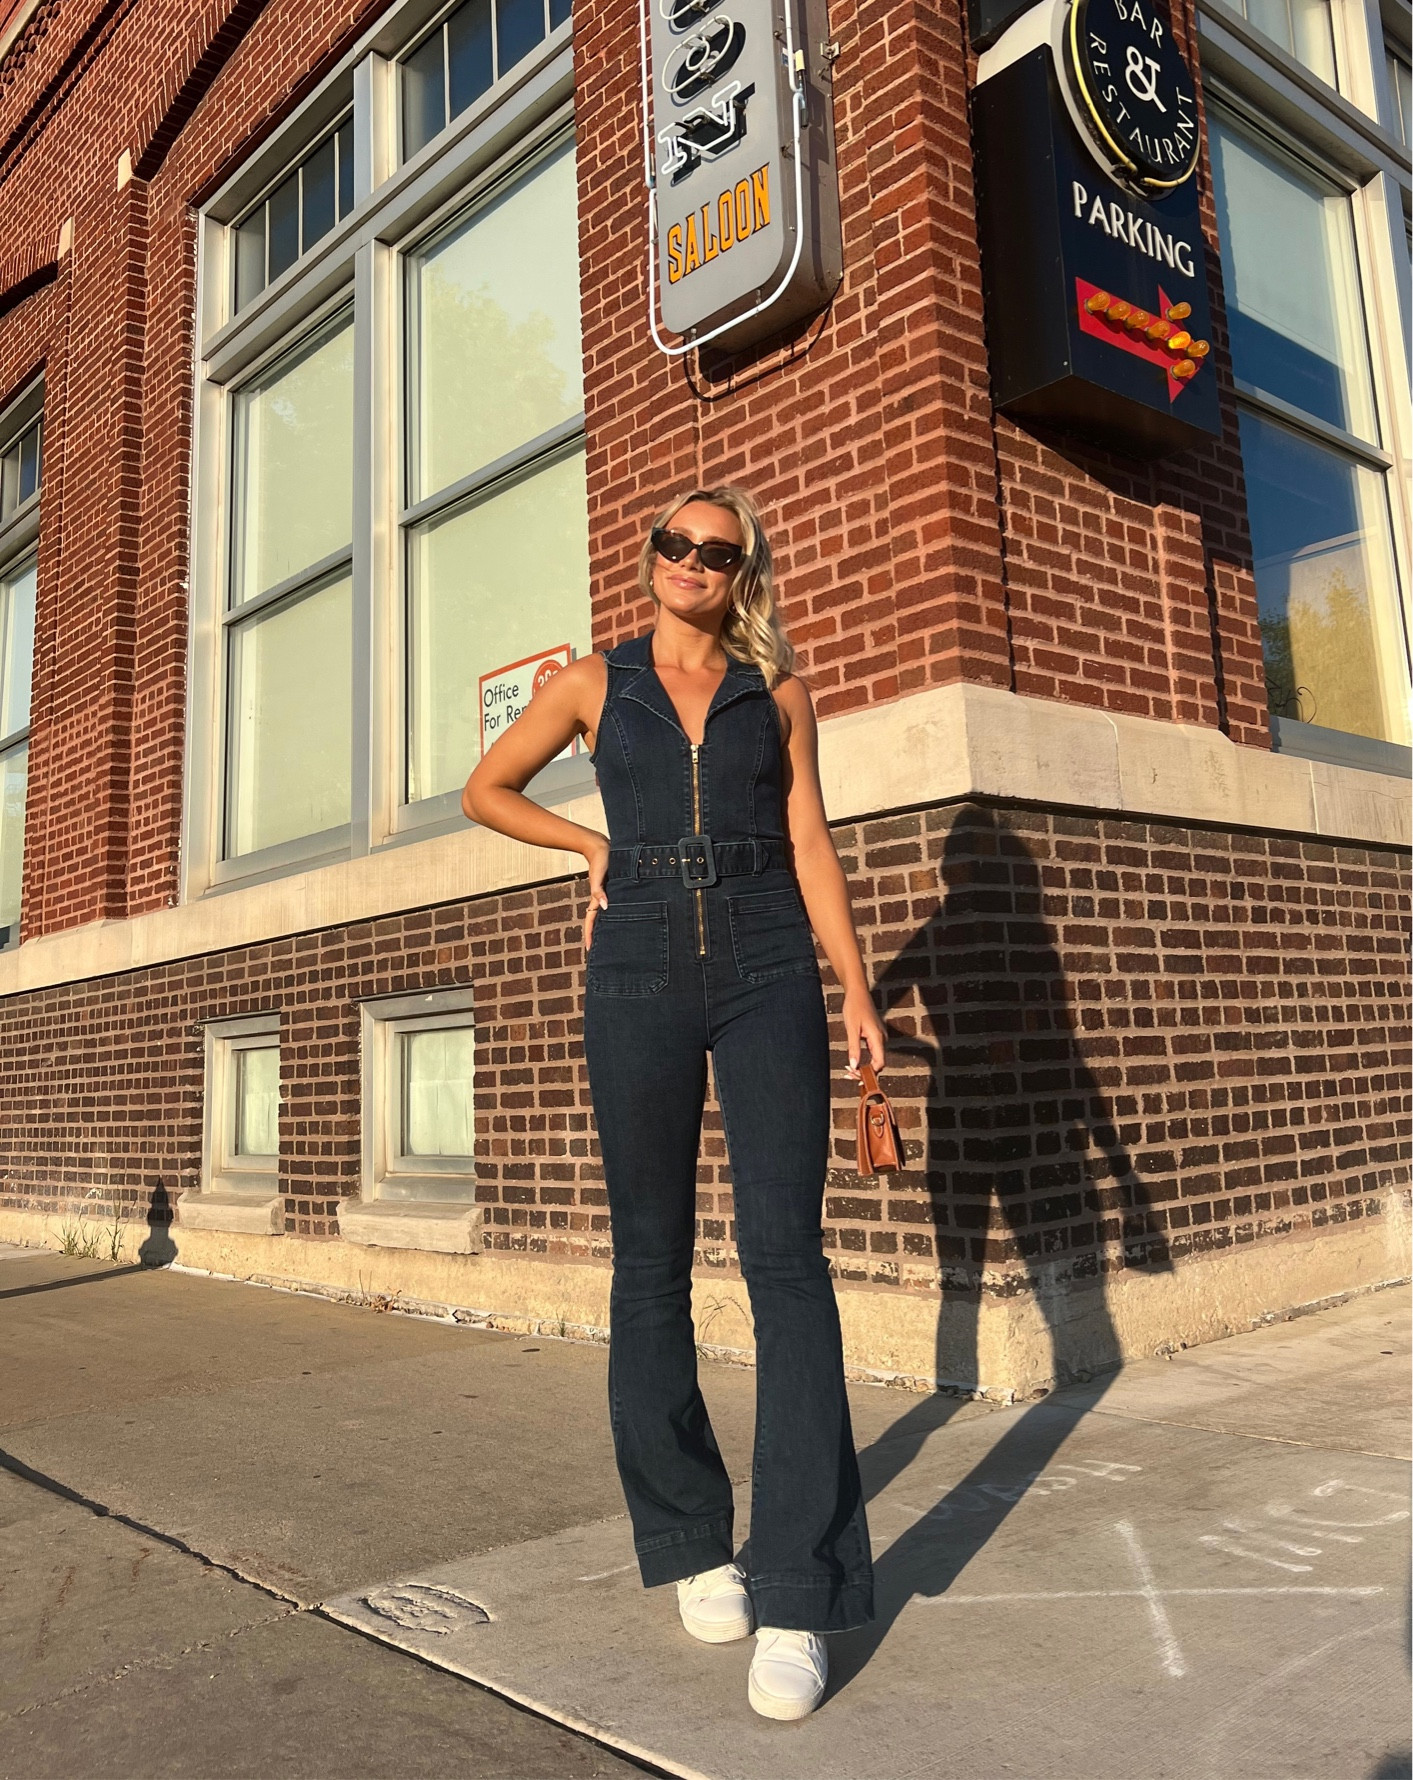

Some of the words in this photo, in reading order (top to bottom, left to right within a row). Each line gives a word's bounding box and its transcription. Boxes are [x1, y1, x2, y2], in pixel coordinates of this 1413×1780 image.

[1114, 0, 1163, 48] BAR
[1090, 32, 1194, 164] RESTAURANT
[1125, 46, 1167, 113] &
[667, 162, 770, 285] SALOON
[1072, 181, 1195, 277] PARKING
[483, 684, 519, 708] Office
[484, 713, 502, 732] For
